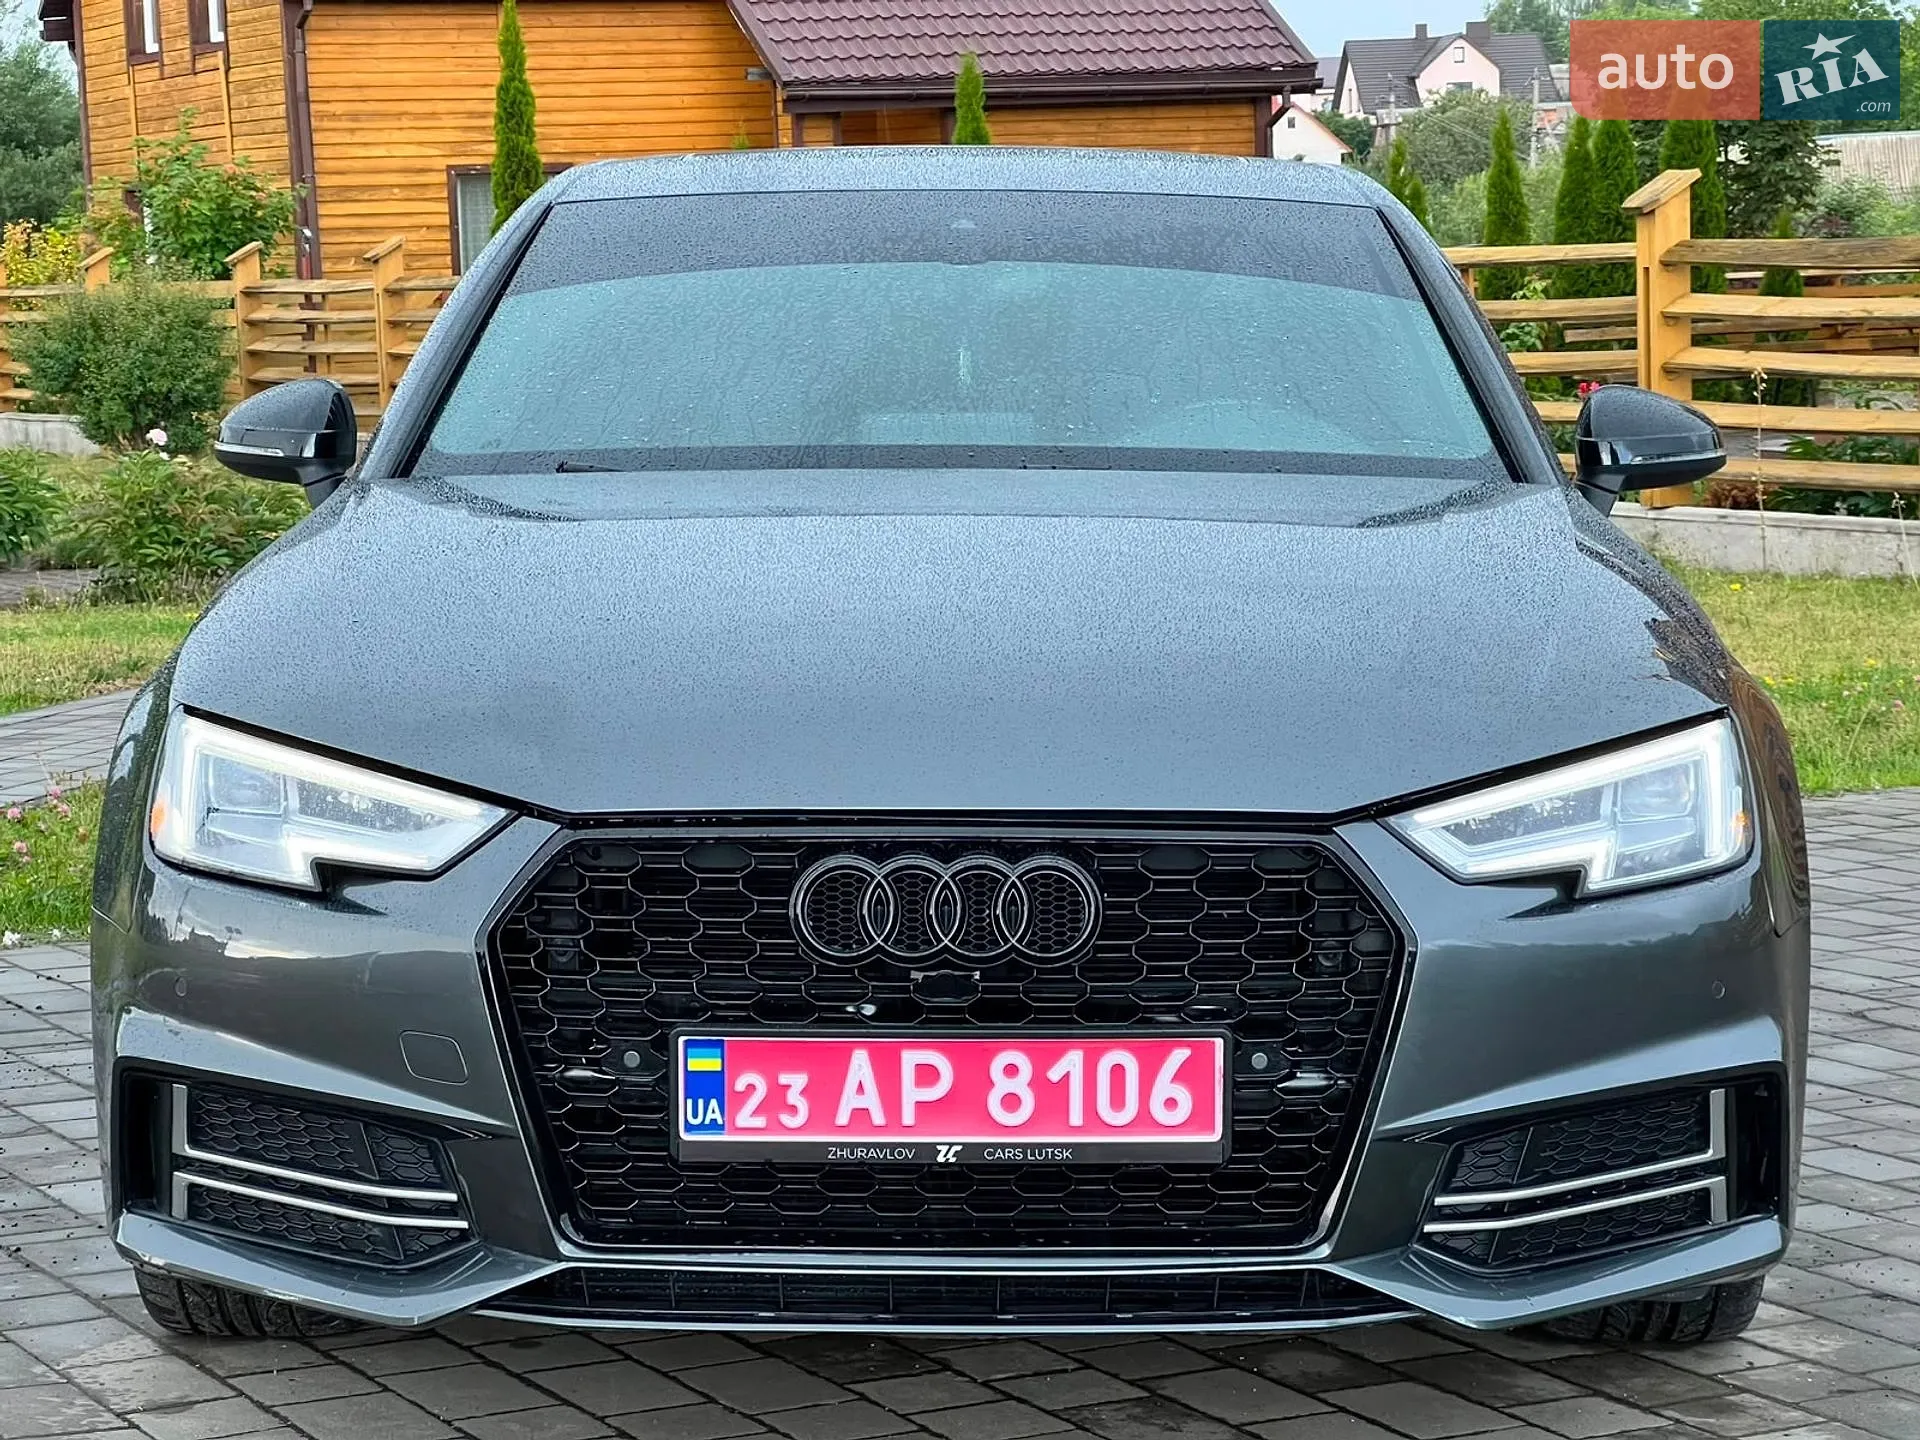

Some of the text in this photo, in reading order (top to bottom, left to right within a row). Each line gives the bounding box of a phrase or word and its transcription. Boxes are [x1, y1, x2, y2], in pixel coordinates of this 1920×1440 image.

[733, 1048, 1193, 1129] 23 AP 8106
[687, 1099, 724, 1125] UA
[827, 1147, 916, 1161] ZHURAVLOV
[983, 1147, 1023, 1161] CARS
[1027, 1147, 1073, 1161] LUTSK
